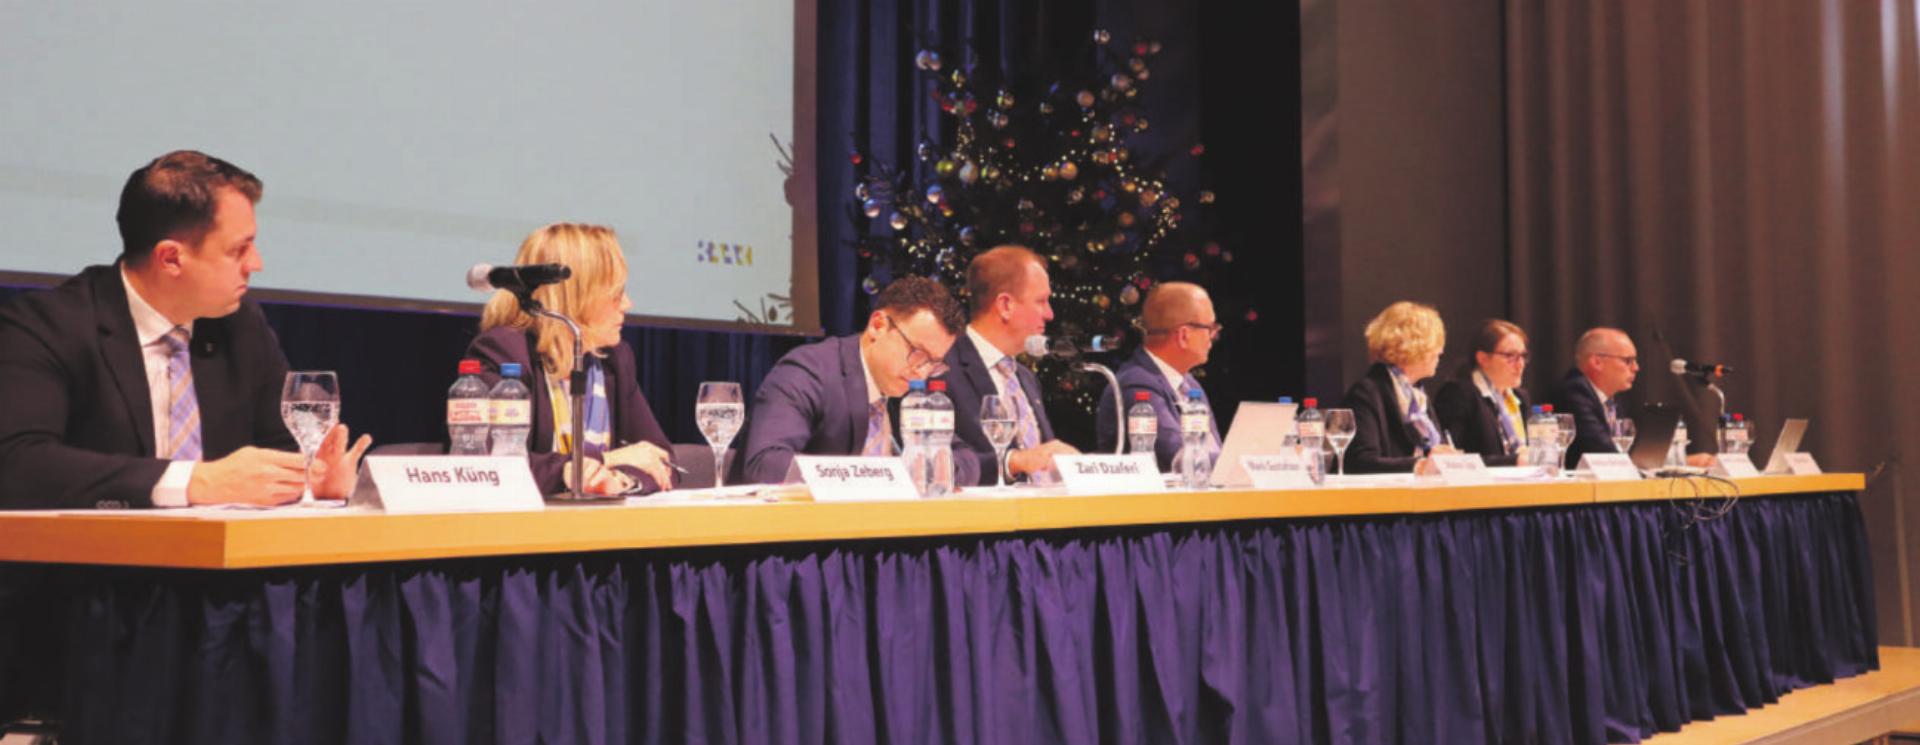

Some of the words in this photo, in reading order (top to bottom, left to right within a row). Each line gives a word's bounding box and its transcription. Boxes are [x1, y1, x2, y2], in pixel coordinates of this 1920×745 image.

[405, 466, 452, 483] Hans
[453, 465, 500, 486] Küng
[815, 464, 849, 481] Sonja
[850, 464, 894, 481] Zeberg
